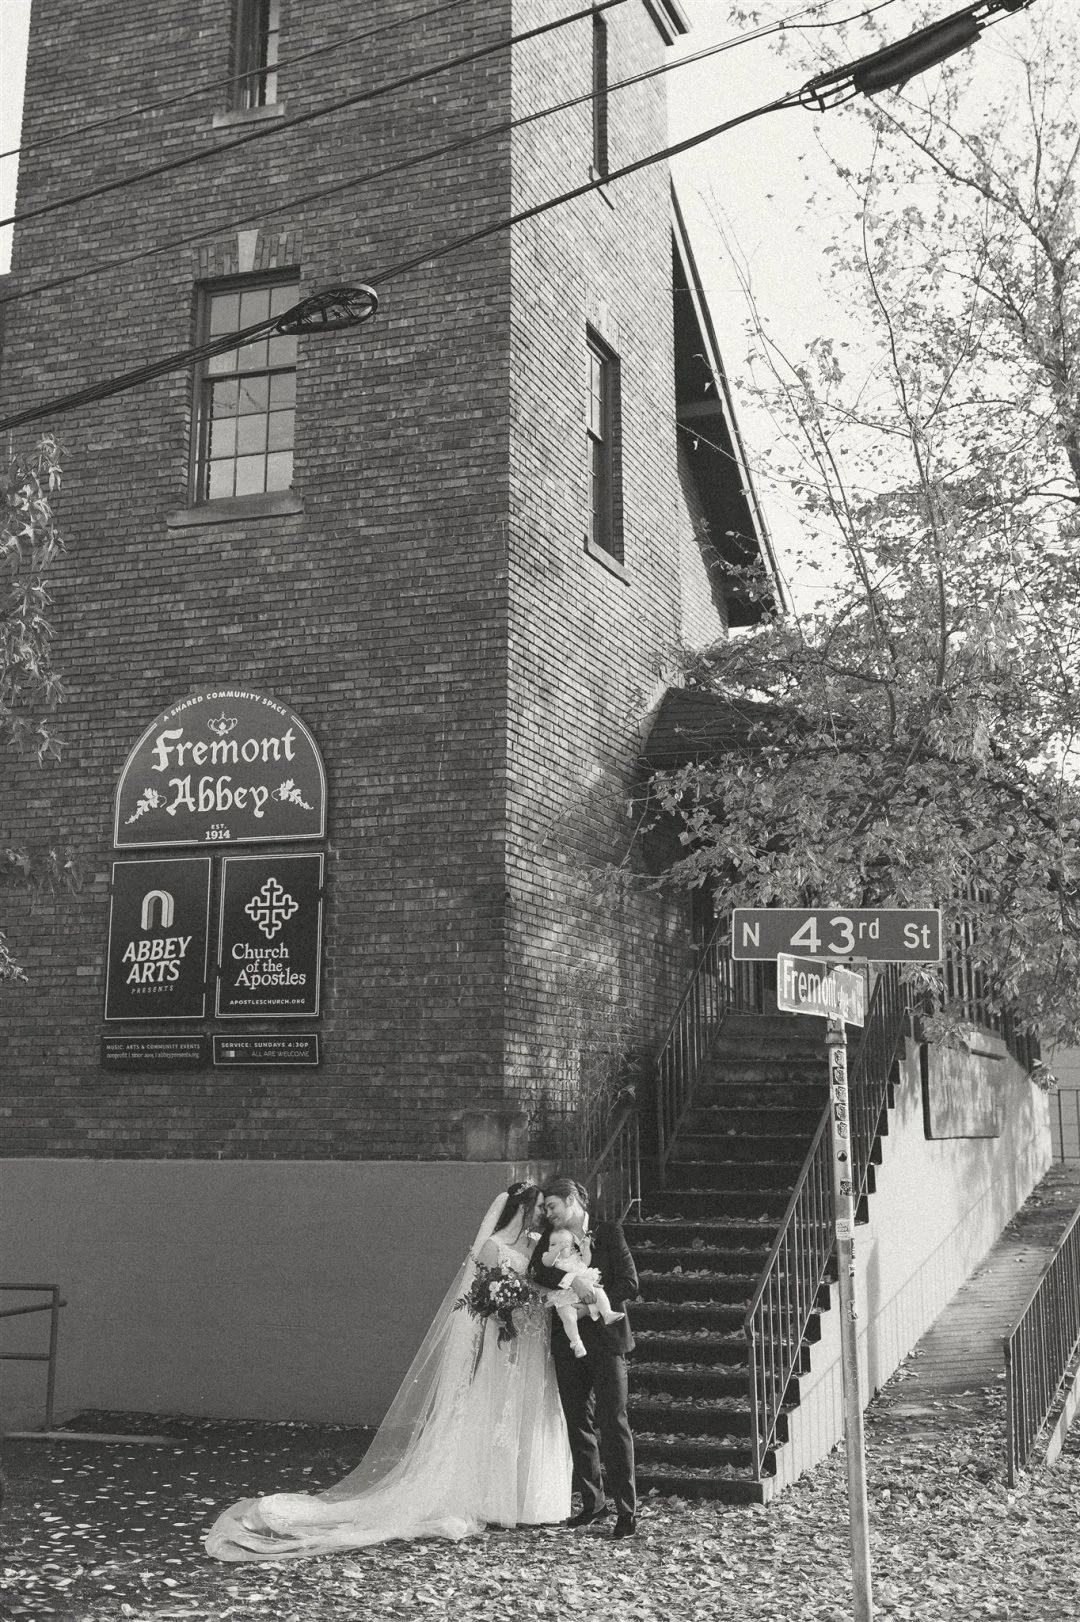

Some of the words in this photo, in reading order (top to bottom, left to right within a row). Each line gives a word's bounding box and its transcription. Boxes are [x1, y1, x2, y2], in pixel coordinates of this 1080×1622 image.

[171, 695, 203, 716] SHARED
[206, 691, 261, 702] COMMUNITY
[262, 697, 287, 716] SPACE
[151, 727, 296, 772] Fremont
[166, 774, 269, 818] Abbey
[205, 830, 231, 840] 1914
[742, 922, 760, 947] N
[903, 922, 931, 949] St
[122, 935, 193, 963] ABBEY
[231, 942, 290, 959] Church
[126, 959, 181, 984] ARTS
[246, 960, 259, 973] of
[262, 959, 283, 972] the
[131, 985, 174, 994] PRESENTS
[233, 968, 306, 990] Apostles
[783, 959, 837, 1008] Fremont
